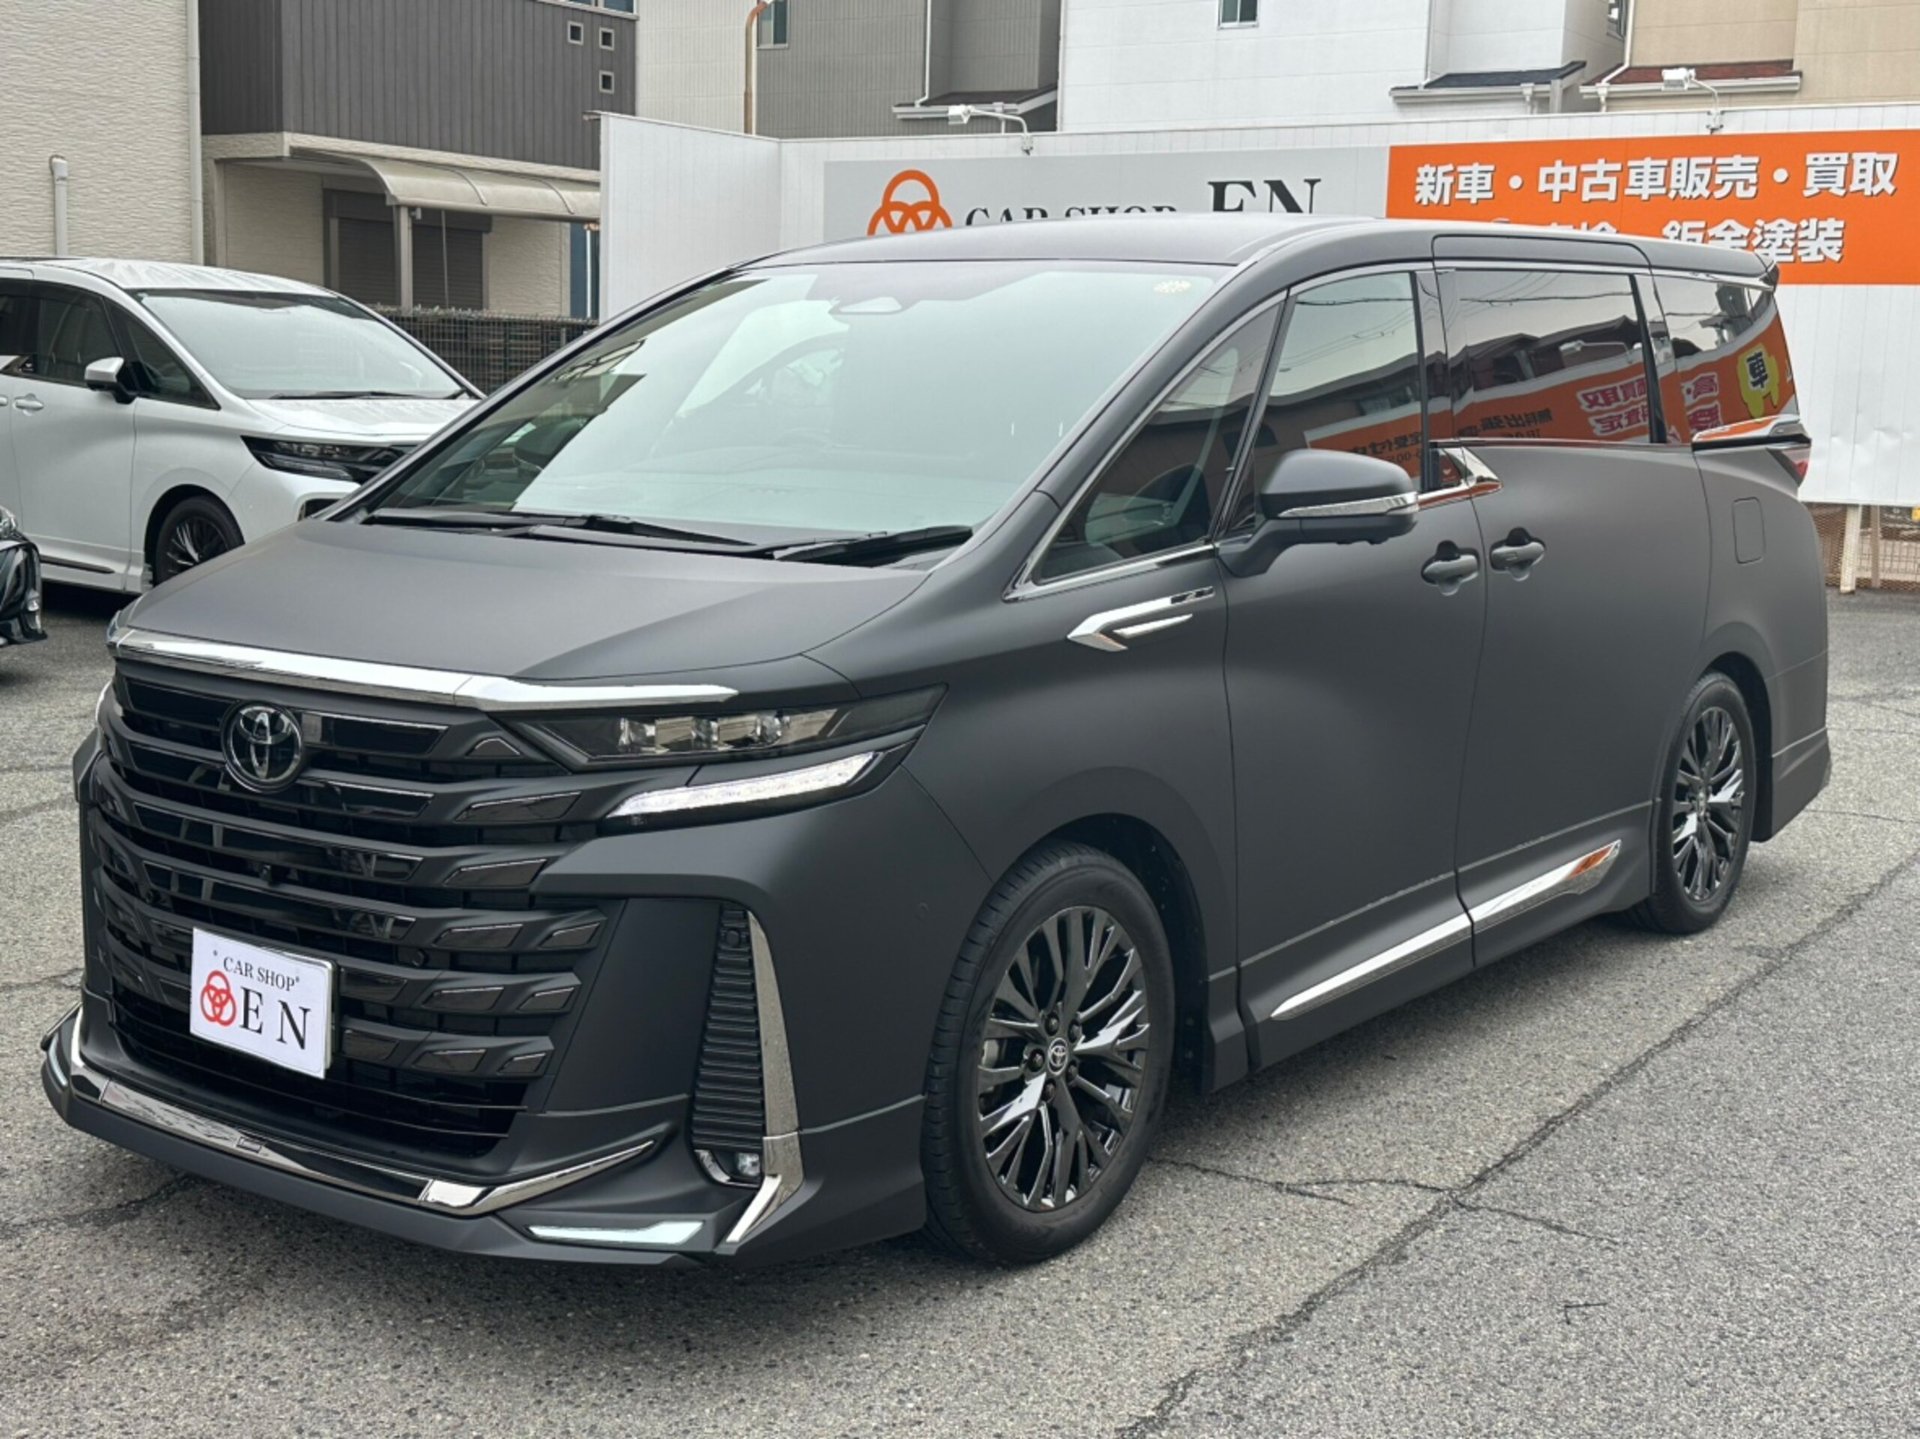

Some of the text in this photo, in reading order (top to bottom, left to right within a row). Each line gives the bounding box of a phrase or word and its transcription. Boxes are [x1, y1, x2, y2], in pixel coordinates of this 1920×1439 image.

[1415, 151, 1898, 206] 新車・中古車販売・買取
[223, 956, 295, 992] CAR SHOP
